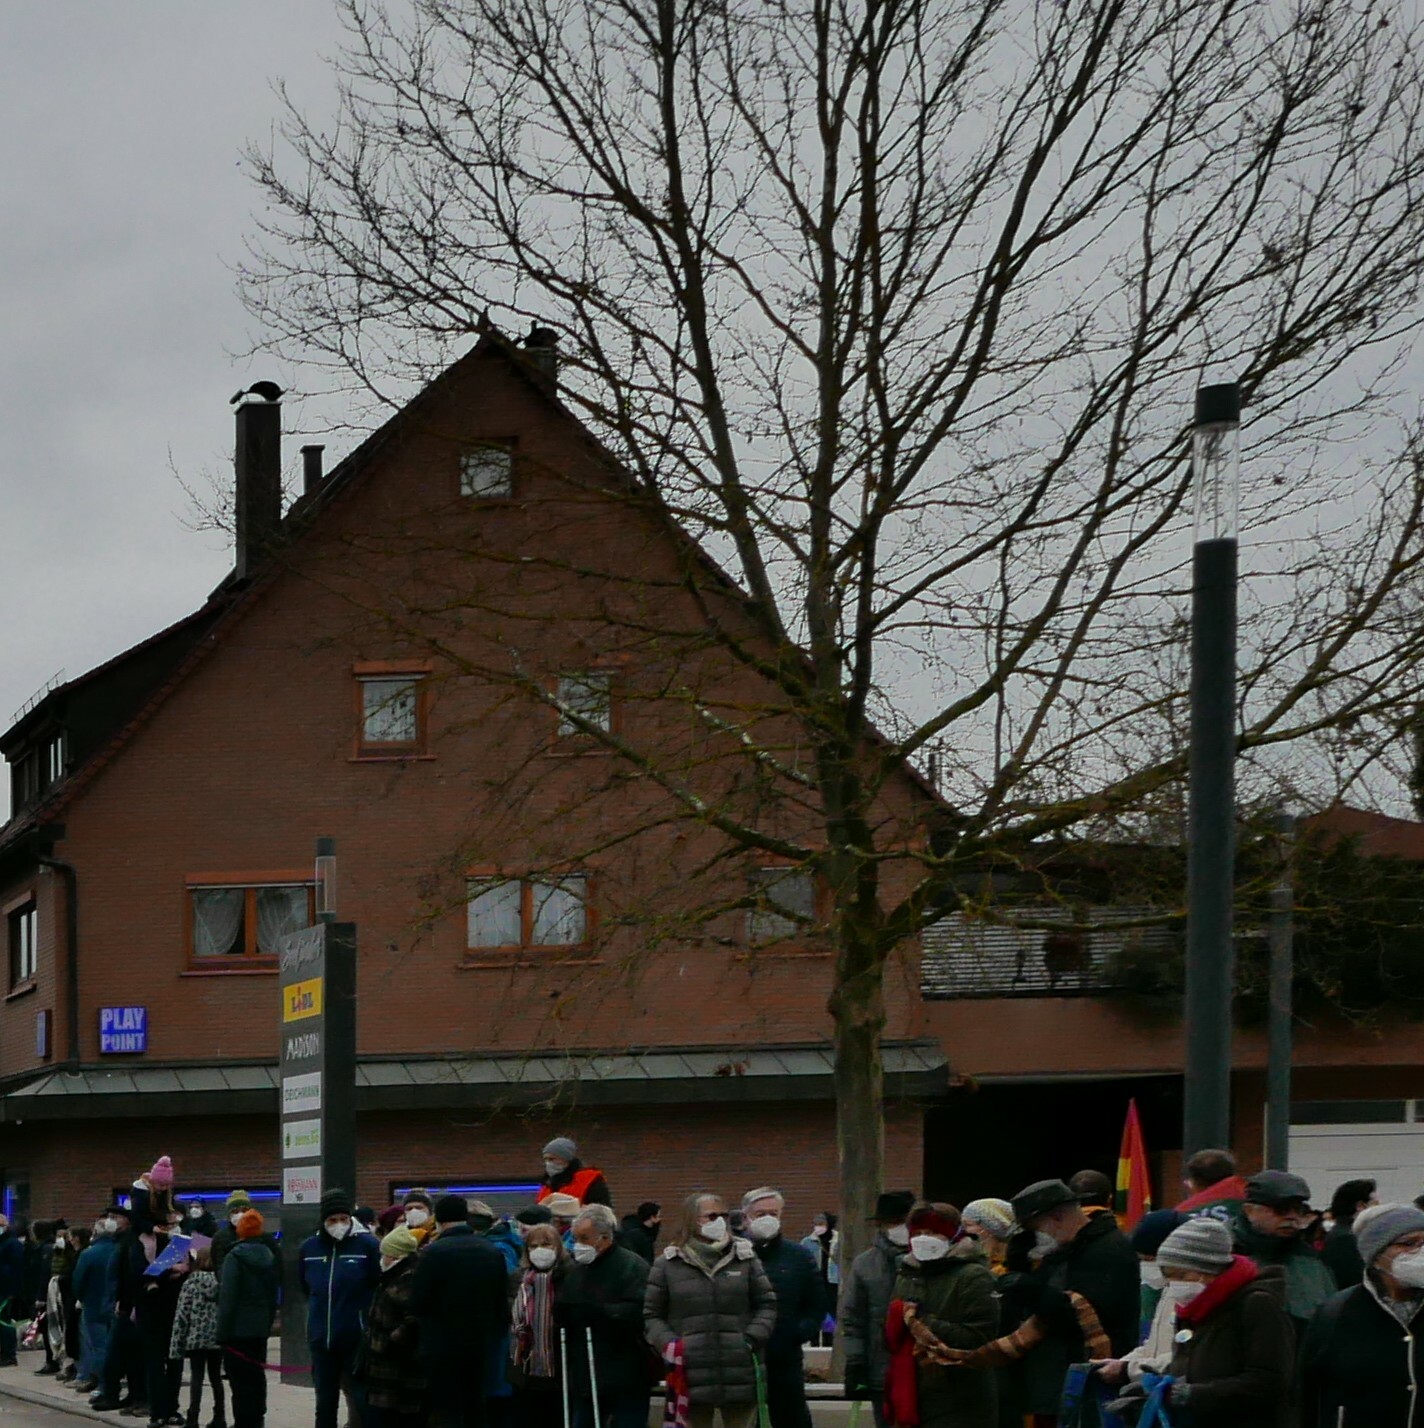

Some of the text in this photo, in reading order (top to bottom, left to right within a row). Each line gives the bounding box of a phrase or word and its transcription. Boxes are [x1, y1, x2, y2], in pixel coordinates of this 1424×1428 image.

[102, 1008, 144, 1030] PLAY
[102, 1033, 144, 1051] POINT
[287, 1032, 320, 1061] MADISON
